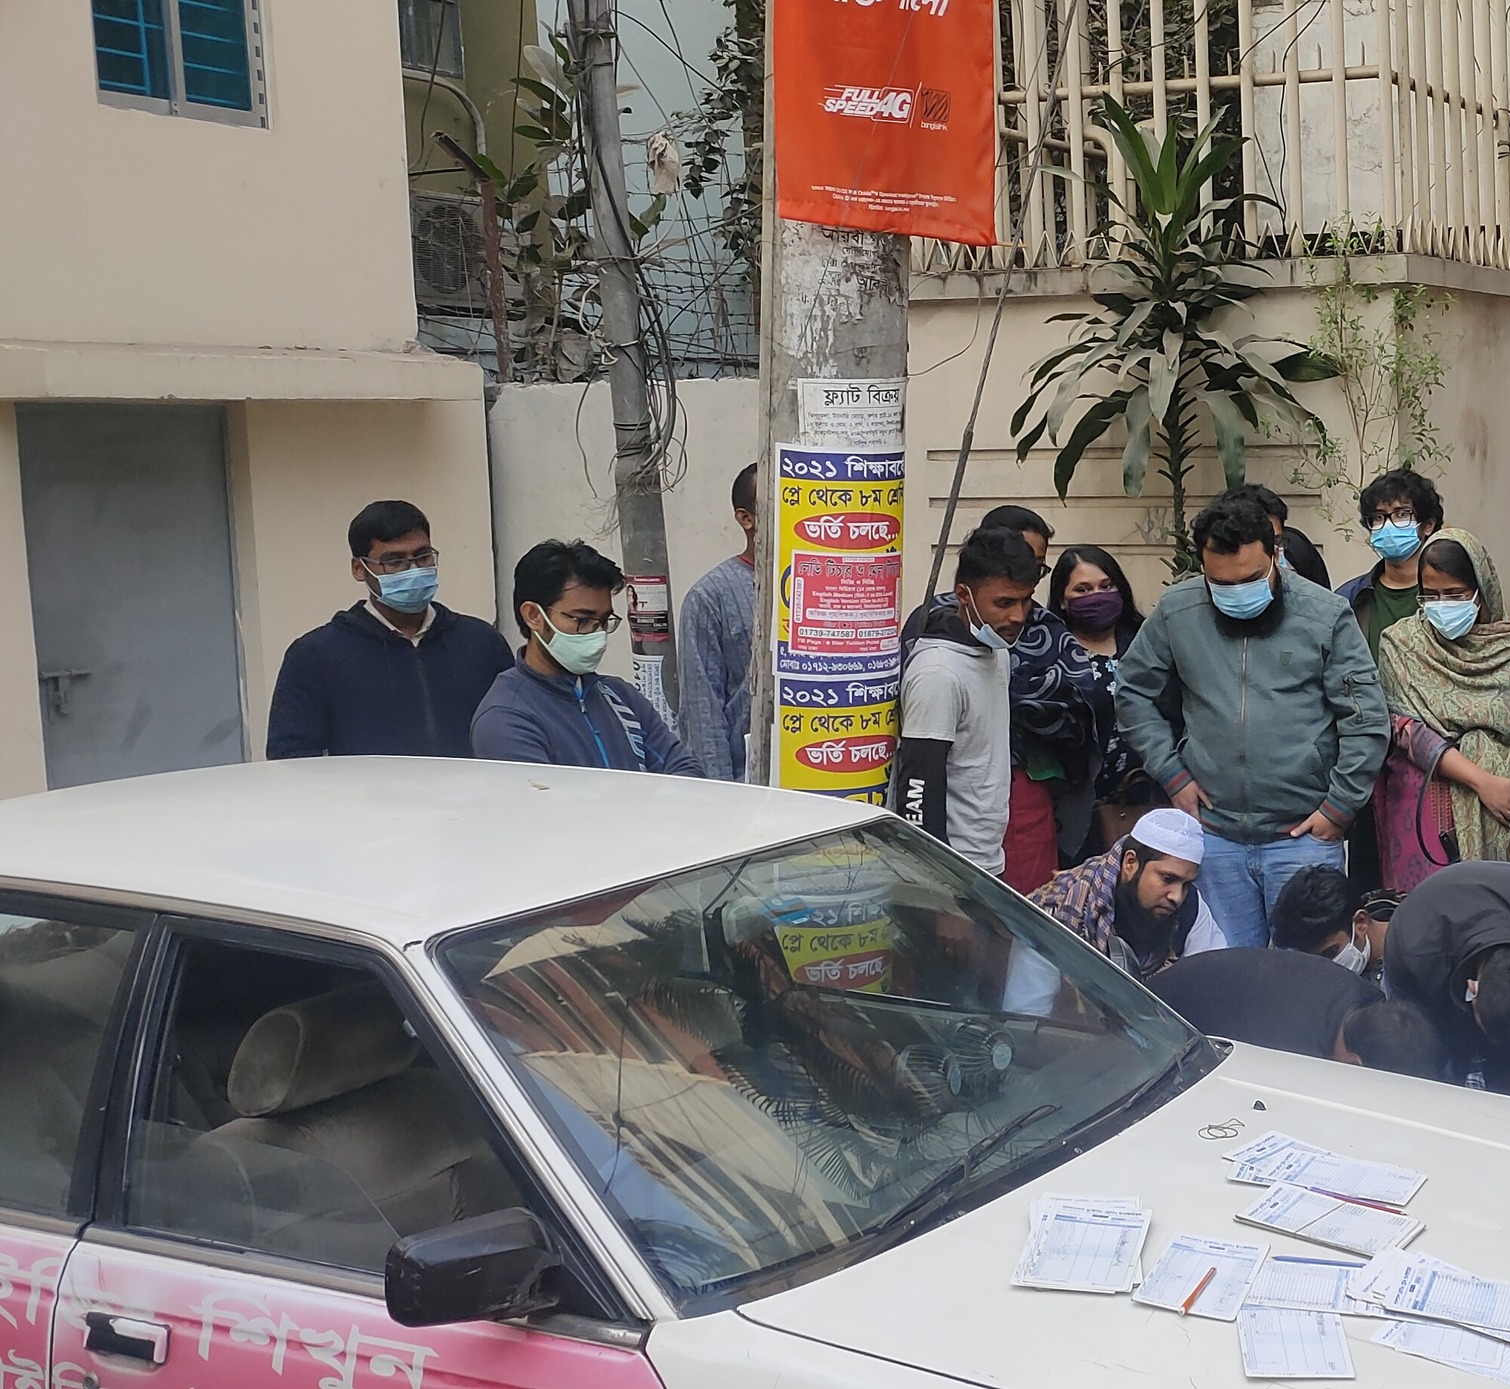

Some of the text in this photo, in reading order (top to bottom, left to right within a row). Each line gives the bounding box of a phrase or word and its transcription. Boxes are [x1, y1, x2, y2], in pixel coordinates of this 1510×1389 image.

[824, 91, 913, 119] SPEED 4G
[842, 88, 880, 102] FULL
[782, 457, 838, 480] ২০২১
[782, 485, 801, 507] প্লে
[808, 486, 855, 507] থেকে
[859, 489, 884, 507] ৮ম
[803, 515, 845, 541] ভর্তি
[782, 685, 839, 706] ২০২১
[783, 713, 802, 734] প্লে
[810, 713, 855, 734] থেকে
[860, 711, 883, 731] ৮ম
[805, 741, 846, 766] ভর্তি
[906, 778, 926, 826] EAM
[809, 932, 854, 952] থেকে
[804, 958, 845, 983] ভর্তি
